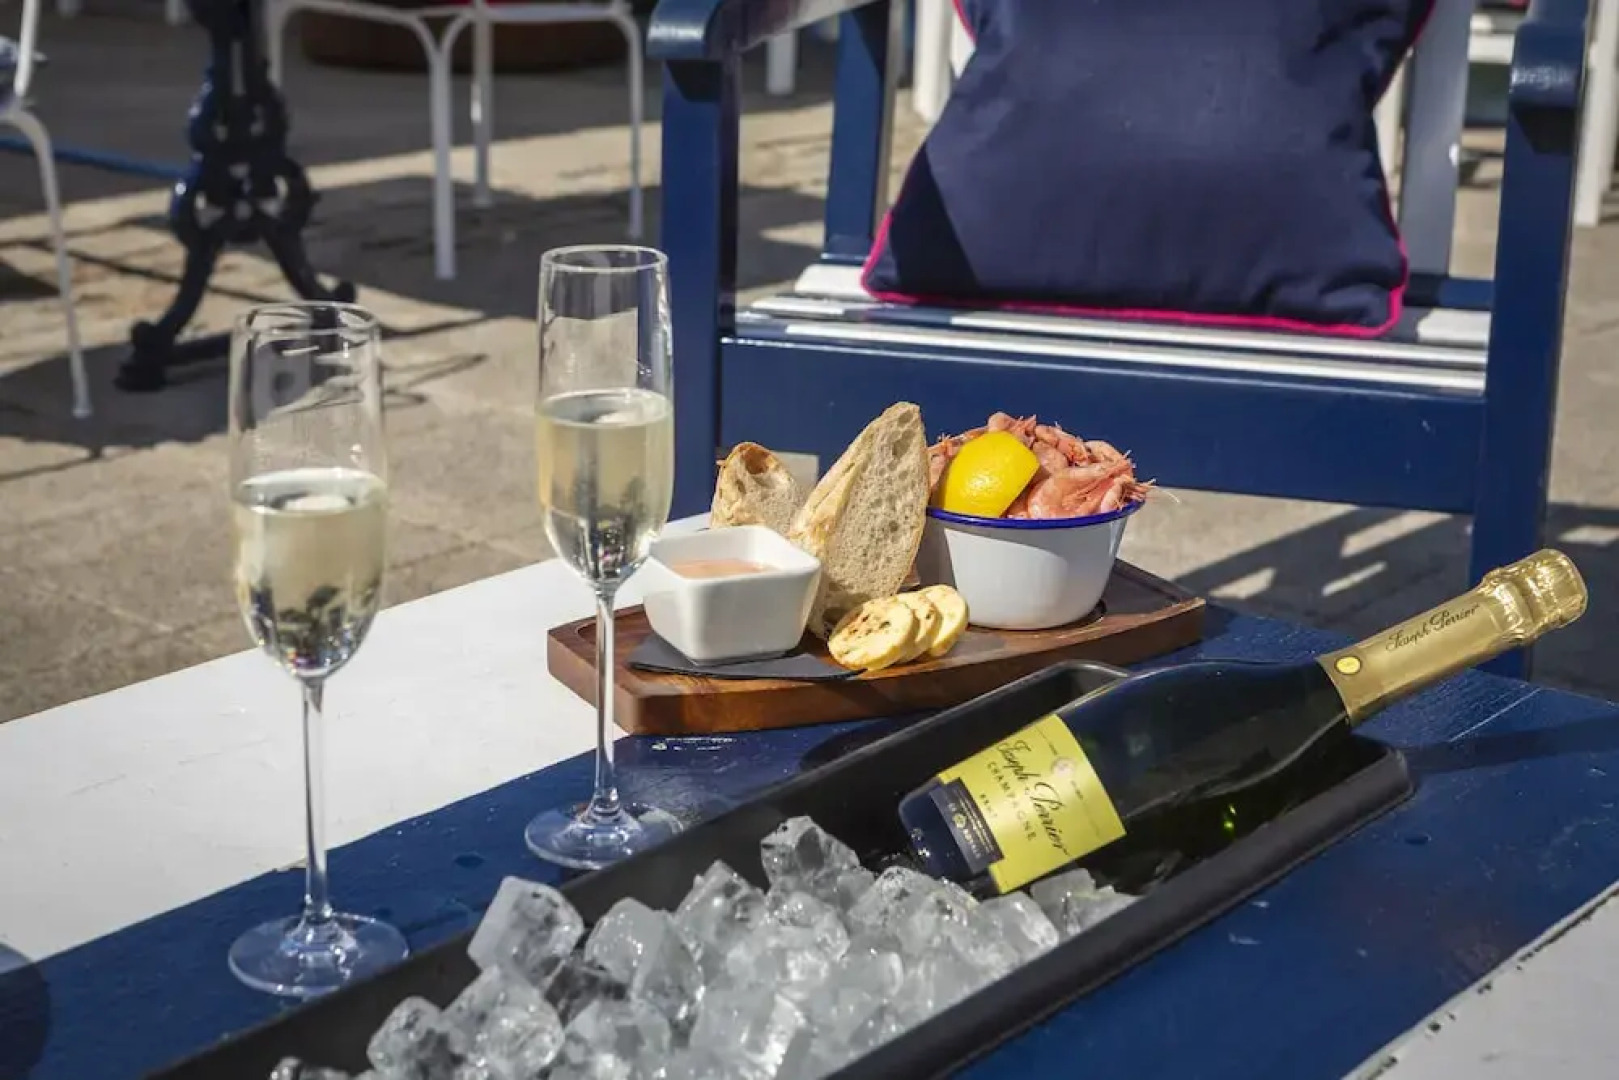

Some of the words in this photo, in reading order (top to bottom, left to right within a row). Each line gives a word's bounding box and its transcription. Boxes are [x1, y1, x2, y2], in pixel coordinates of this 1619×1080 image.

[1385, 622, 1431, 651] Joseph
[1429, 603, 1480, 631] Perrier
[987, 761, 1037, 841] CHAMPAGNE
[997, 740, 1041, 781] Joseph
[1029, 781, 1072, 856] Perrier
